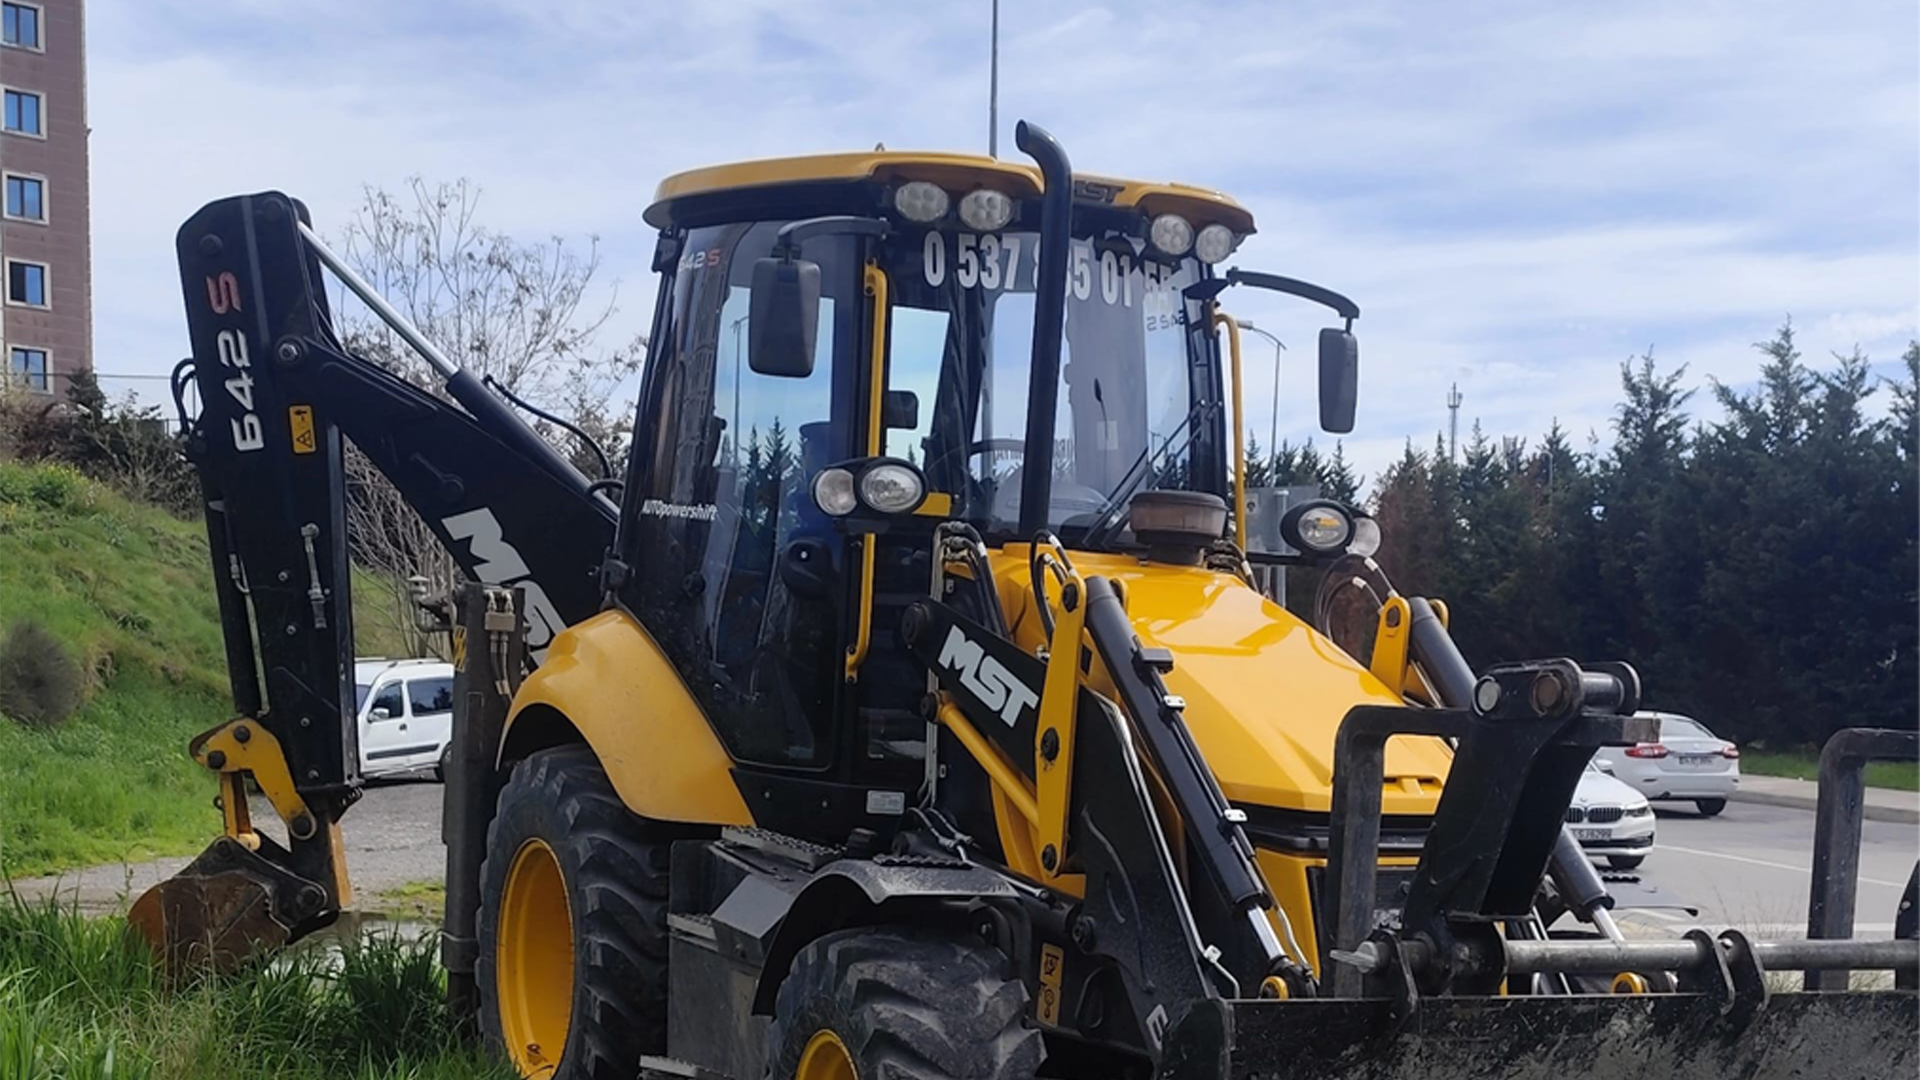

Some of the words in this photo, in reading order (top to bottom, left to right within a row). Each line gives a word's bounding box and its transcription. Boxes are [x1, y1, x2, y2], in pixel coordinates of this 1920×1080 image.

[206, 271, 241, 314] S
[708, 249, 721, 266] S
[924, 231, 945, 287] 0
[957, 231, 1020, 290] 537
[1101, 250, 1132, 307] 01
[217, 328, 264, 451] 642
[938, 624, 1039, 727] MST
